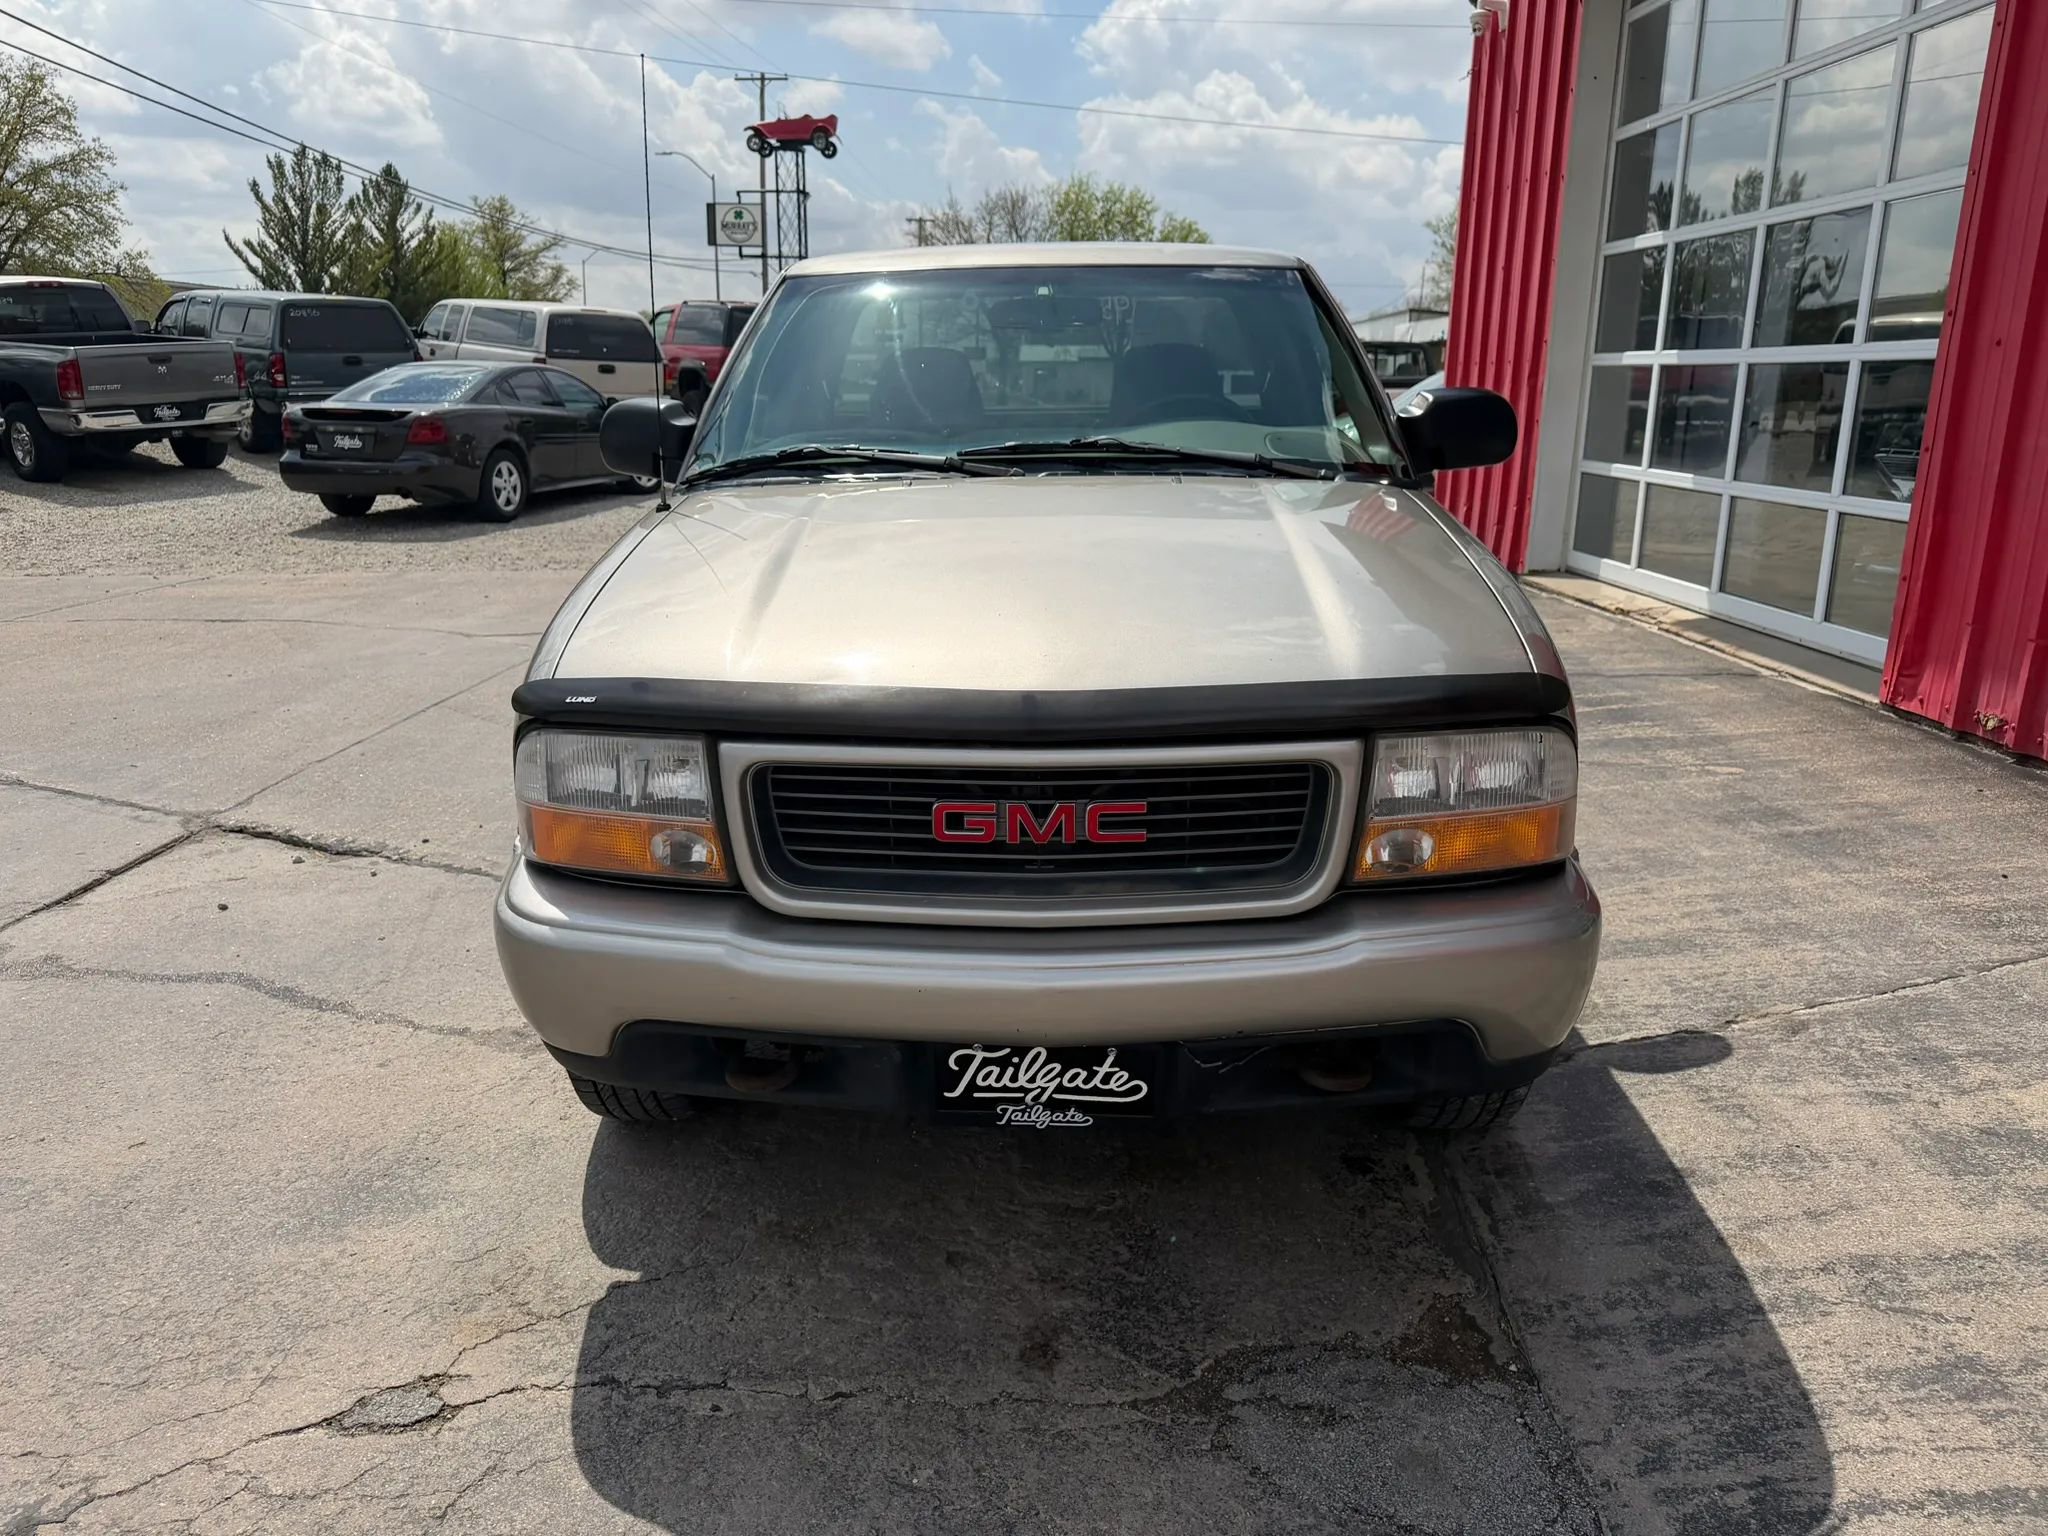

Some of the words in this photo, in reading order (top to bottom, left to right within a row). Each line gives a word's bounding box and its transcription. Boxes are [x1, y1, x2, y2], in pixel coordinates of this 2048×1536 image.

[932, 802, 1147, 844] GMC
[943, 1046, 1148, 1105] Tailgate
[996, 1104, 1093, 1129] Tailgate
